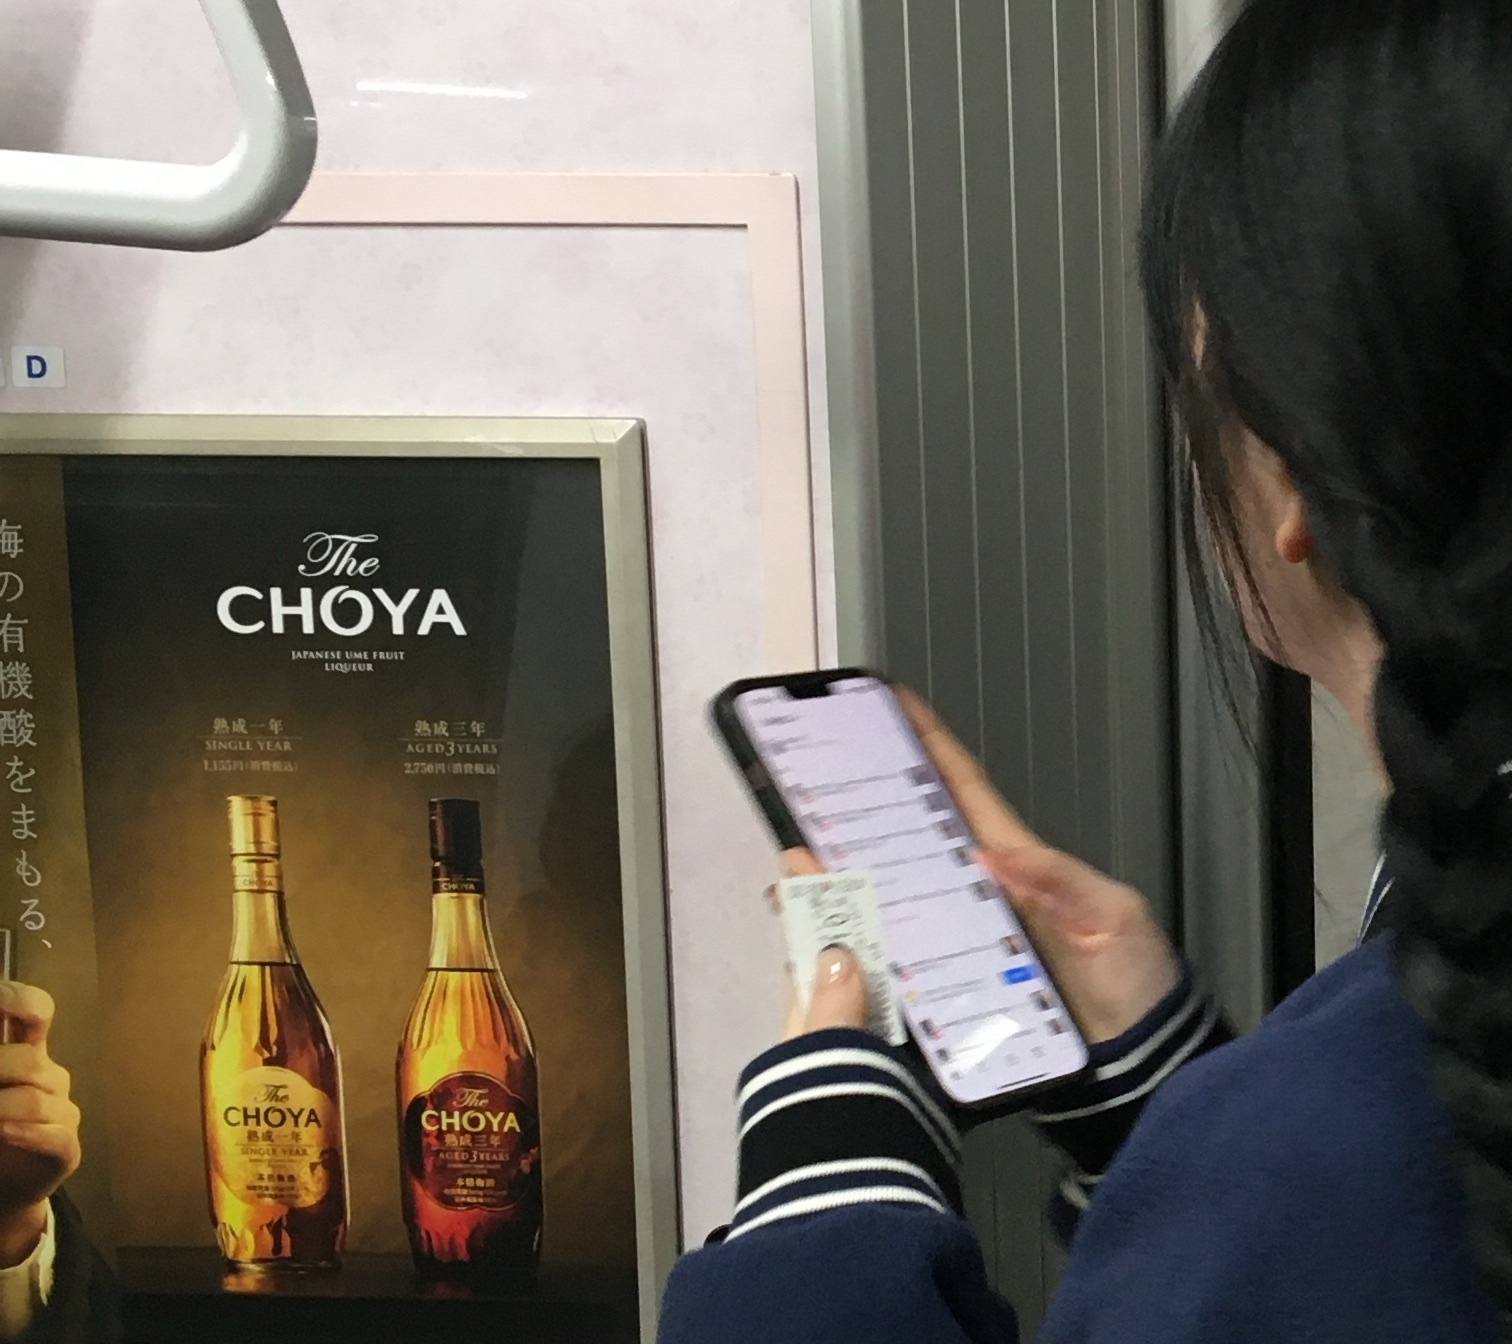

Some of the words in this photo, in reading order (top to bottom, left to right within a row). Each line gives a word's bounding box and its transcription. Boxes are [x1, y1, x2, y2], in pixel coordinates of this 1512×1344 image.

[26, 355, 47, 379] D
[298, 531, 381, 577] The
[216, 585, 468, 637] CHOYA
[291, 649, 342, 660] JAPANESE
[345, 650, 369, 661] UME
[372, 650, 405, 661] FRUIT
[325, 662, 374, 673] LIQUEUR
[213, 717, 284, 735] 熟成一年
[414, 719, 486, 737] 熟成三年
[205, 739, 253, 751] SINGLE
[257, 740, 293, 752] YEAR
[253, 1083, 290, 1103] The
[452, 1087, 489, 1108] The
[223, 1105, 322, 1128] CHOYA
[421, 1109, 521, 1133] CHOYA
